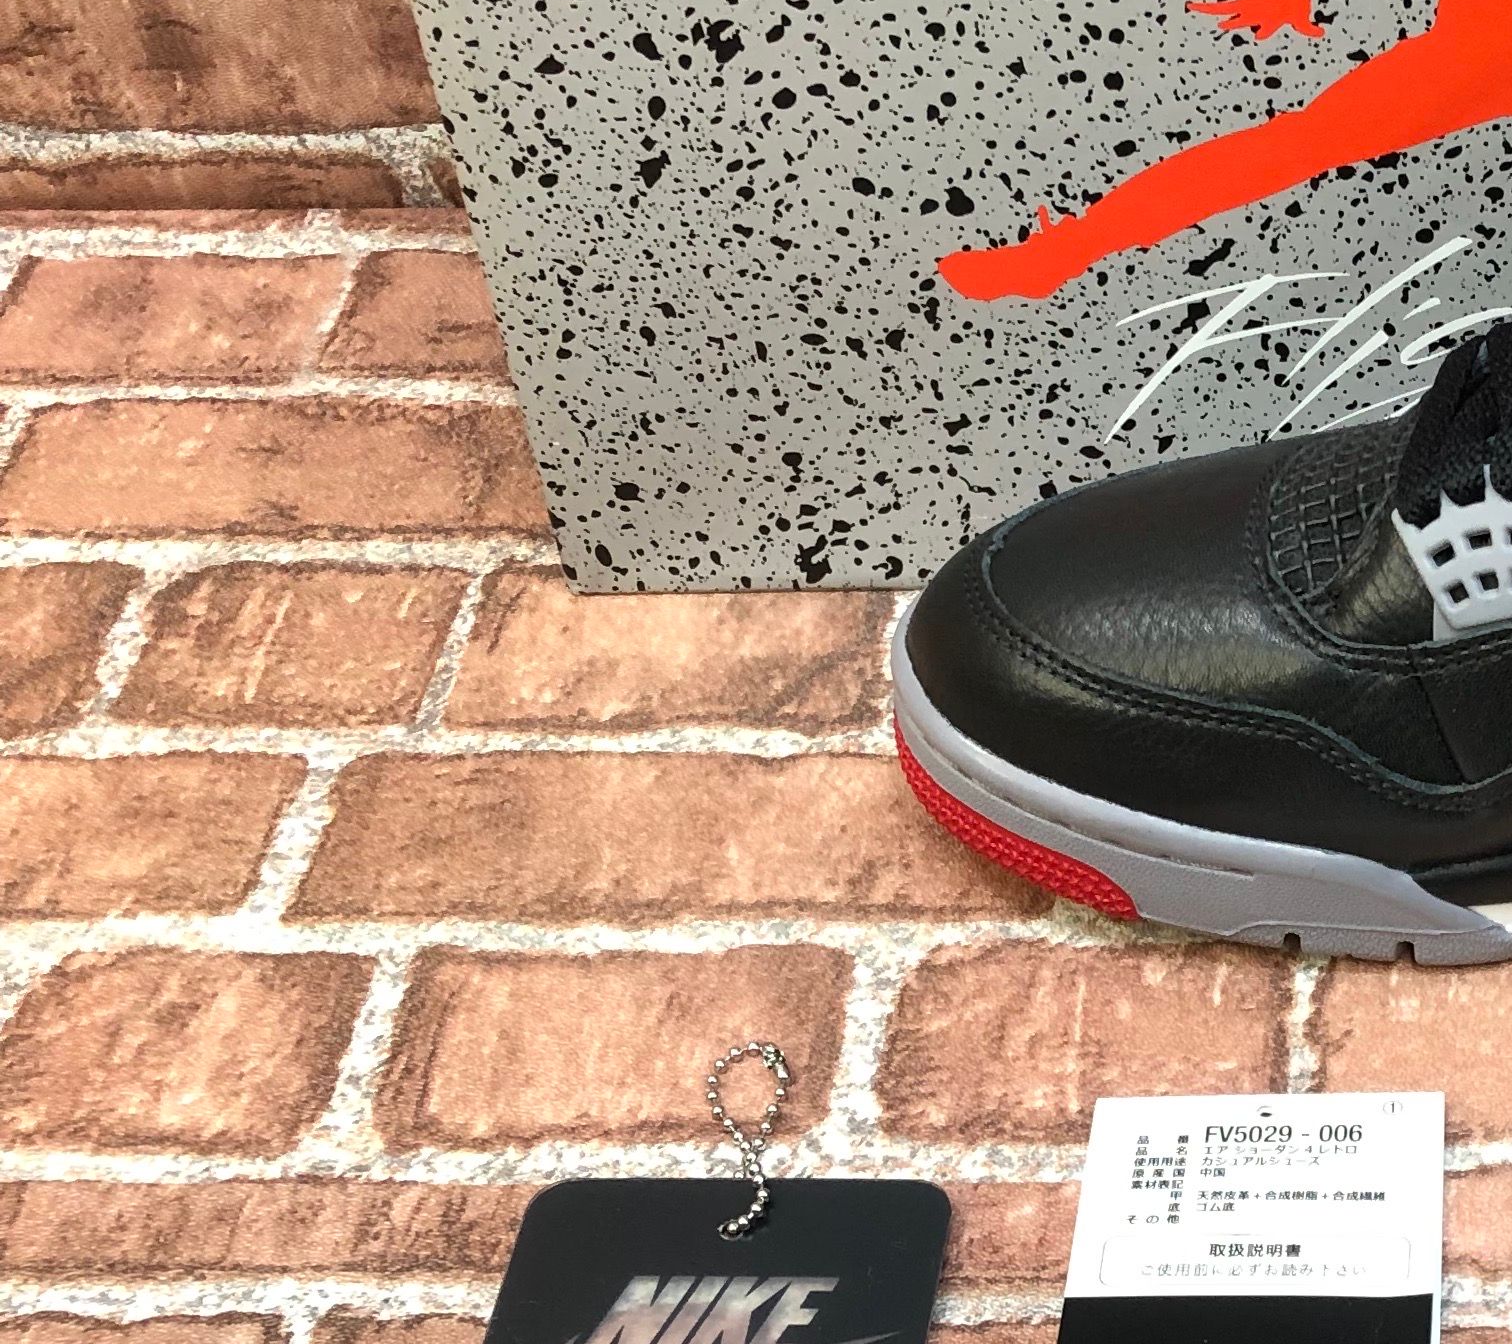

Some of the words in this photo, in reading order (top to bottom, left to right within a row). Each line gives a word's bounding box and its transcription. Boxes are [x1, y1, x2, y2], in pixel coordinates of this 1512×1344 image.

[1204, 1125, 1293, 1143] FV5029
[1319, 1124, 1363, 1142] 006
[1199, 1167, 1226, 1178] 中国
[1209, 1243, 1302, 1257] 取扱説明書
